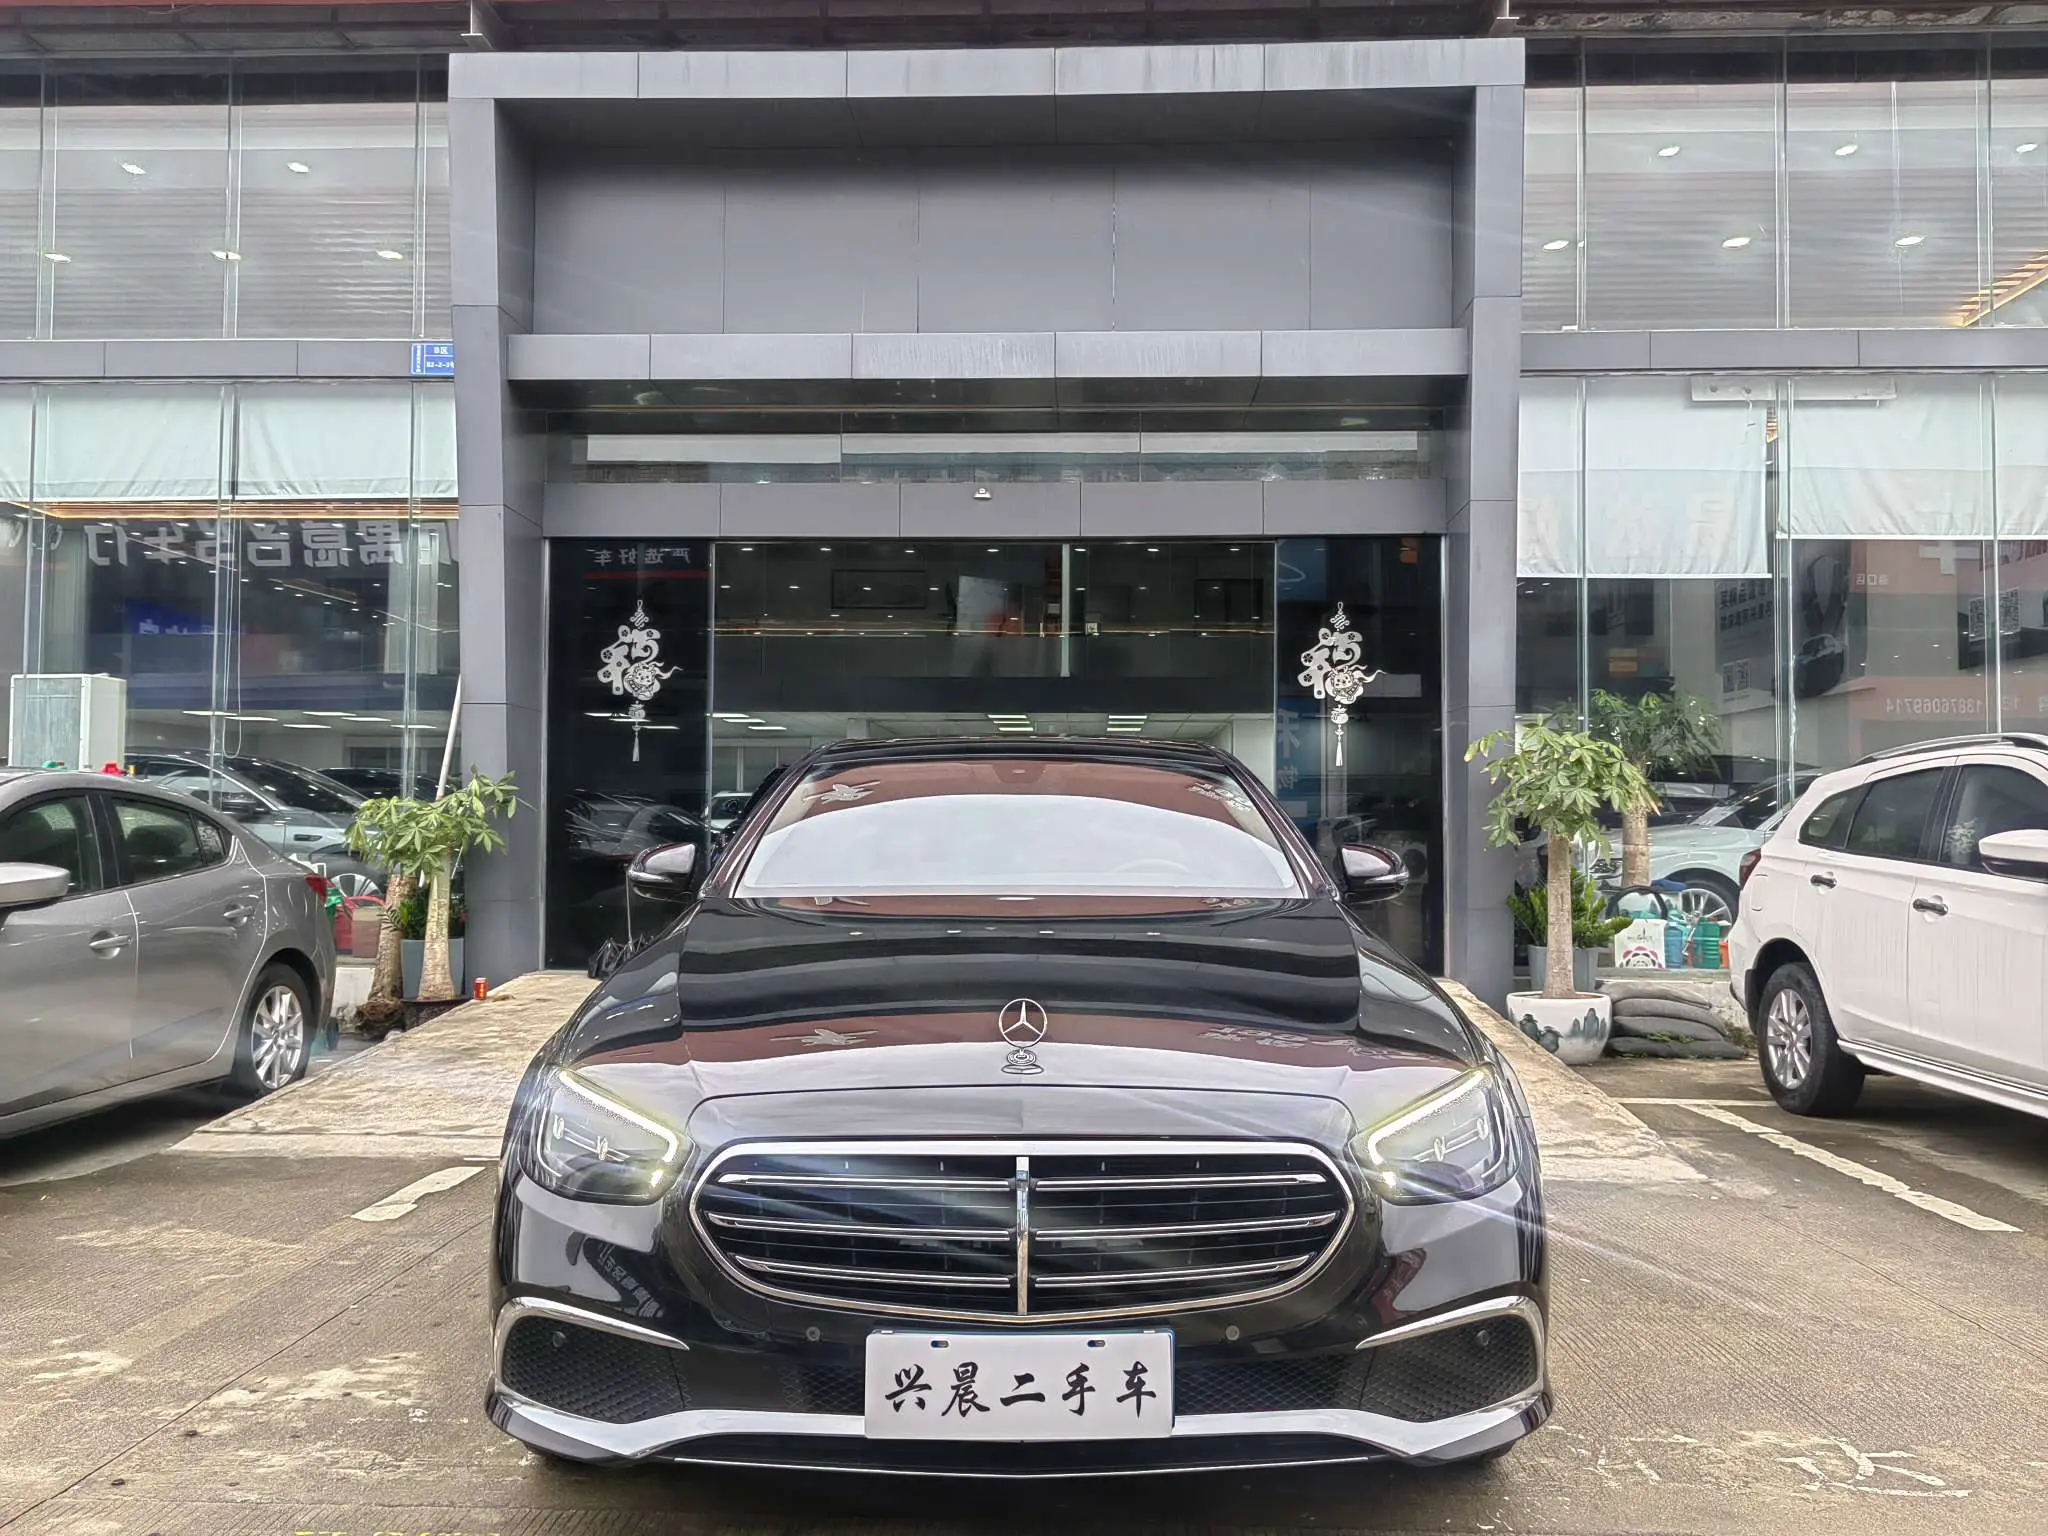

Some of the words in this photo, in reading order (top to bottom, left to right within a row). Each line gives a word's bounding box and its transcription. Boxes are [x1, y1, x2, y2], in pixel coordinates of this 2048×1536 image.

[884, 1361, 1157, 1418] 兴晨二手车
